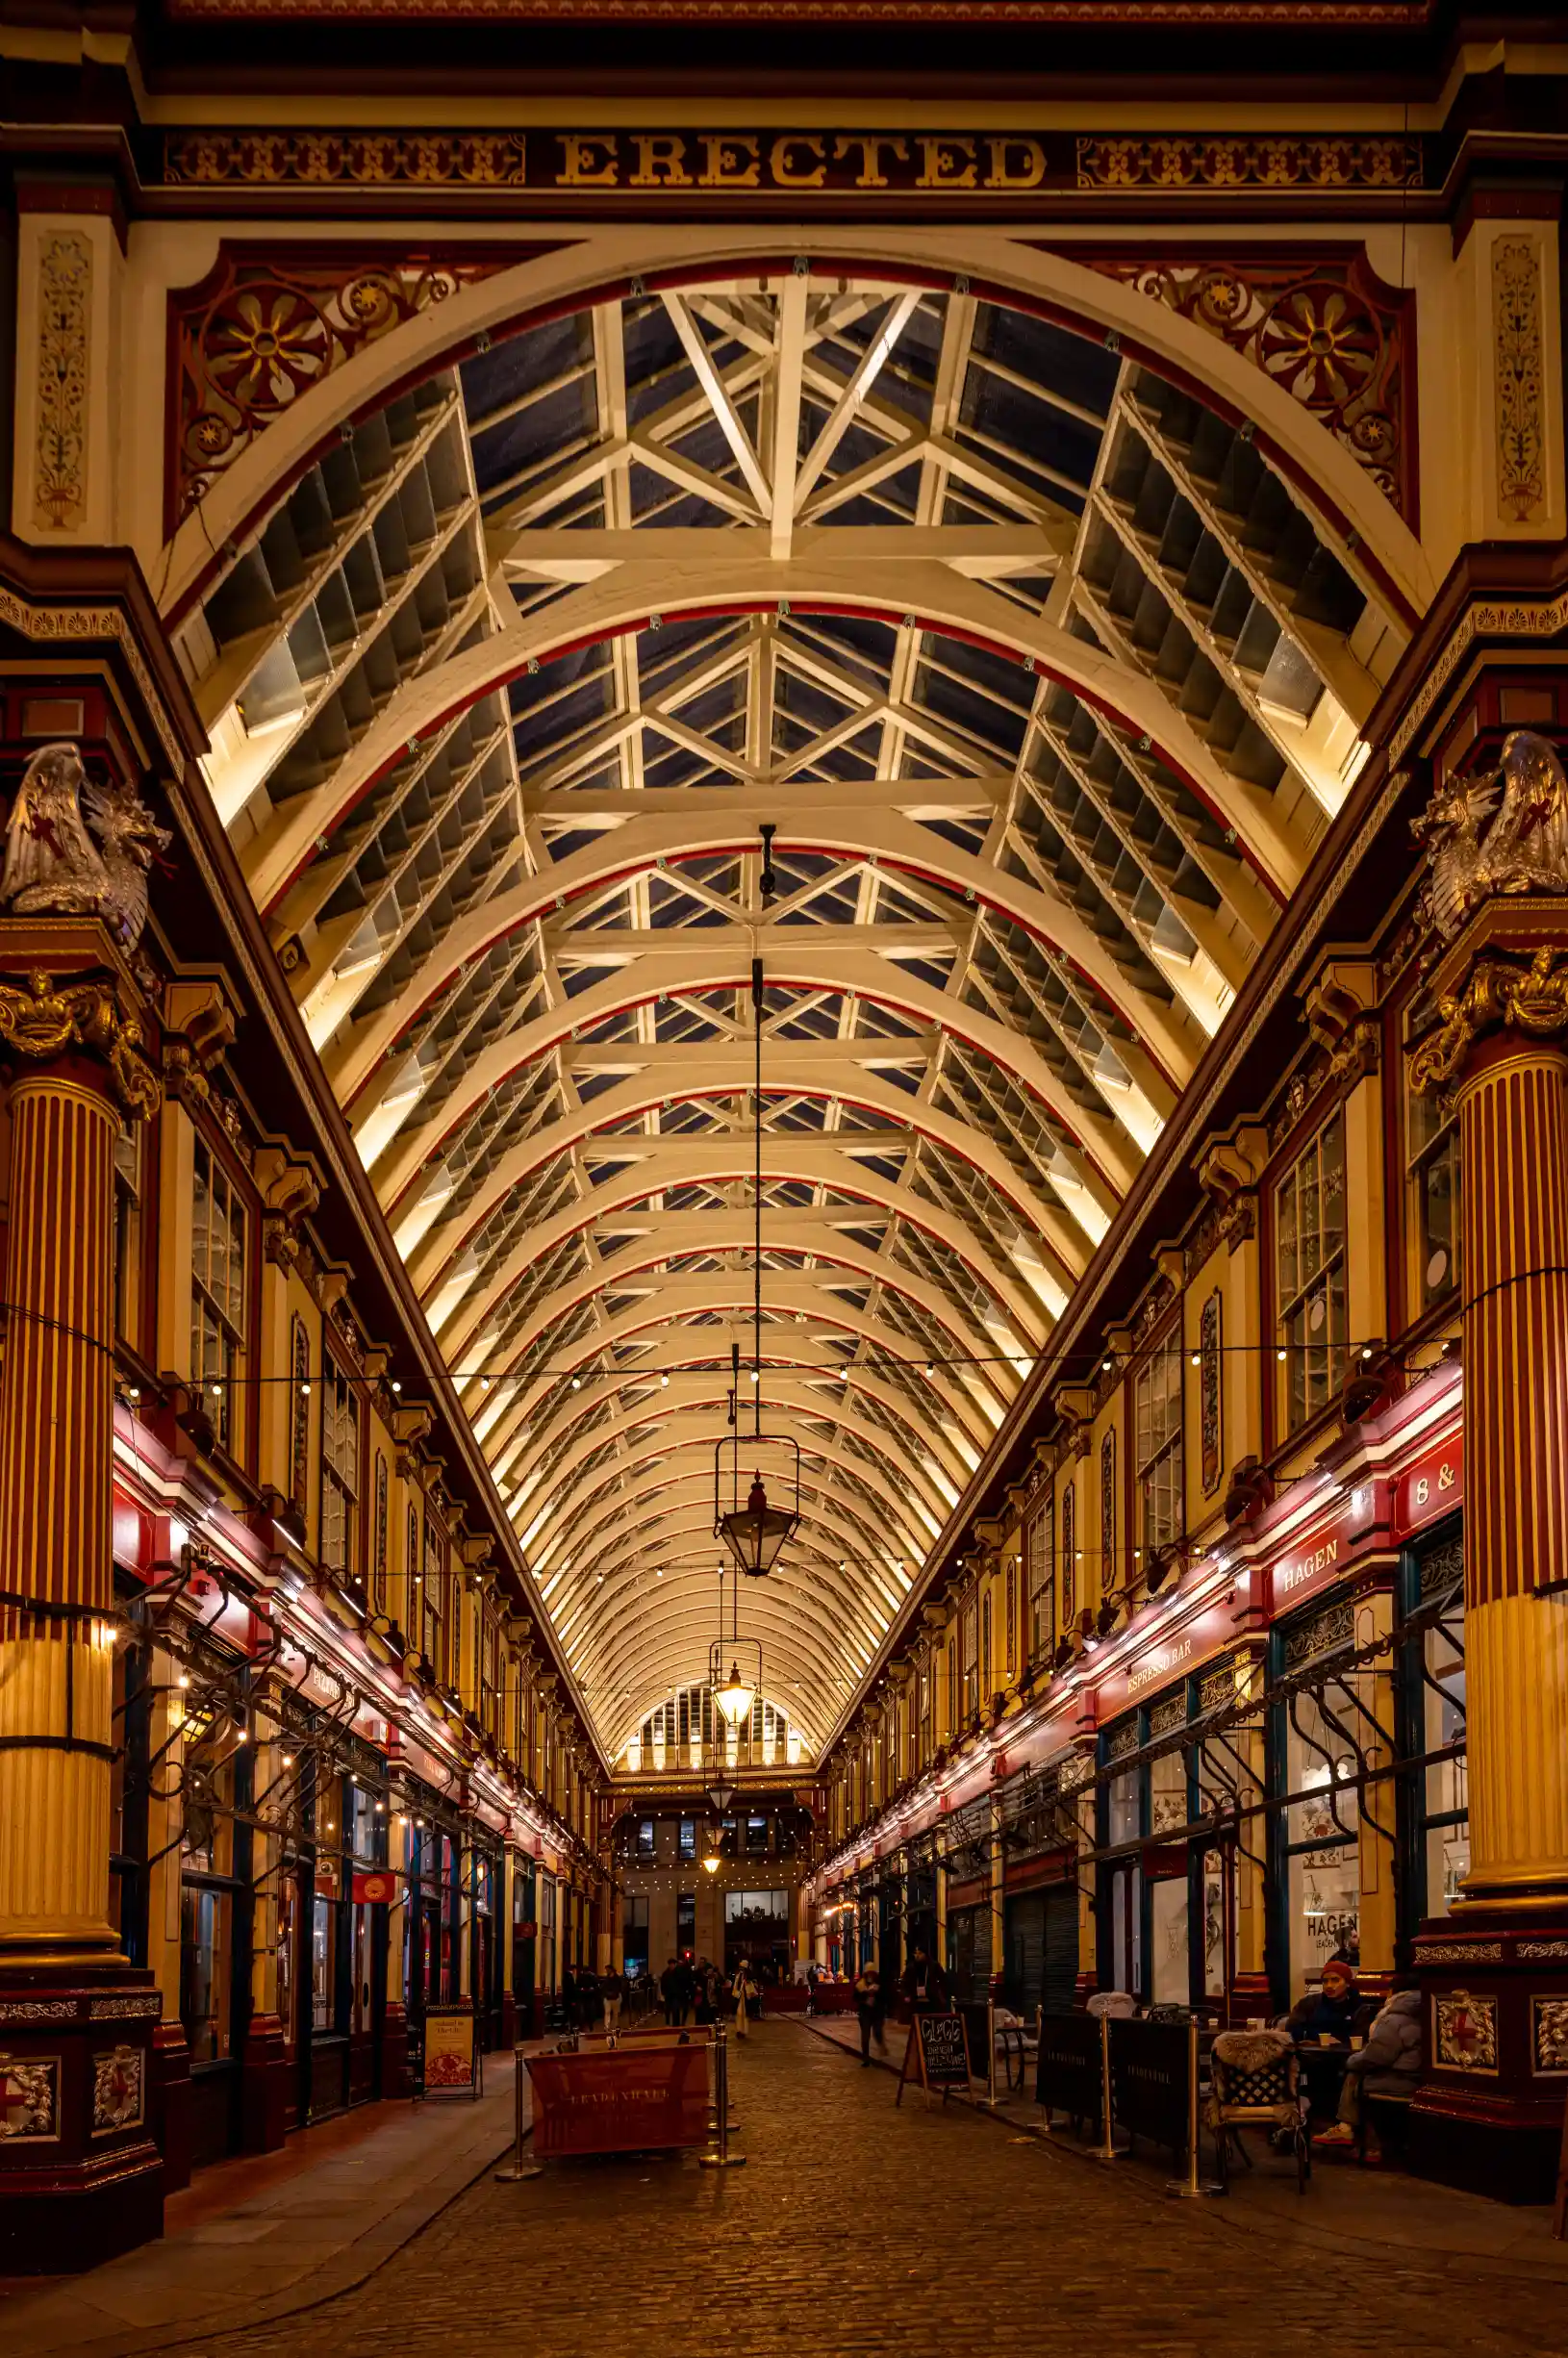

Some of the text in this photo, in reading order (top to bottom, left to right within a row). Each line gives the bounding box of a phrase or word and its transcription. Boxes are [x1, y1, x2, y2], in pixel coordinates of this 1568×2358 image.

[555, 134, 1049, 189] ERECTED
[1416, 1462, 1455, 1506] 8 &
[1282, 1538, 1338, 1593] HAGEN
[1126, 1637, 1193, 1694] ESPRESSO BAR
[1307, 1913, 1357, 1937] HAGEN
